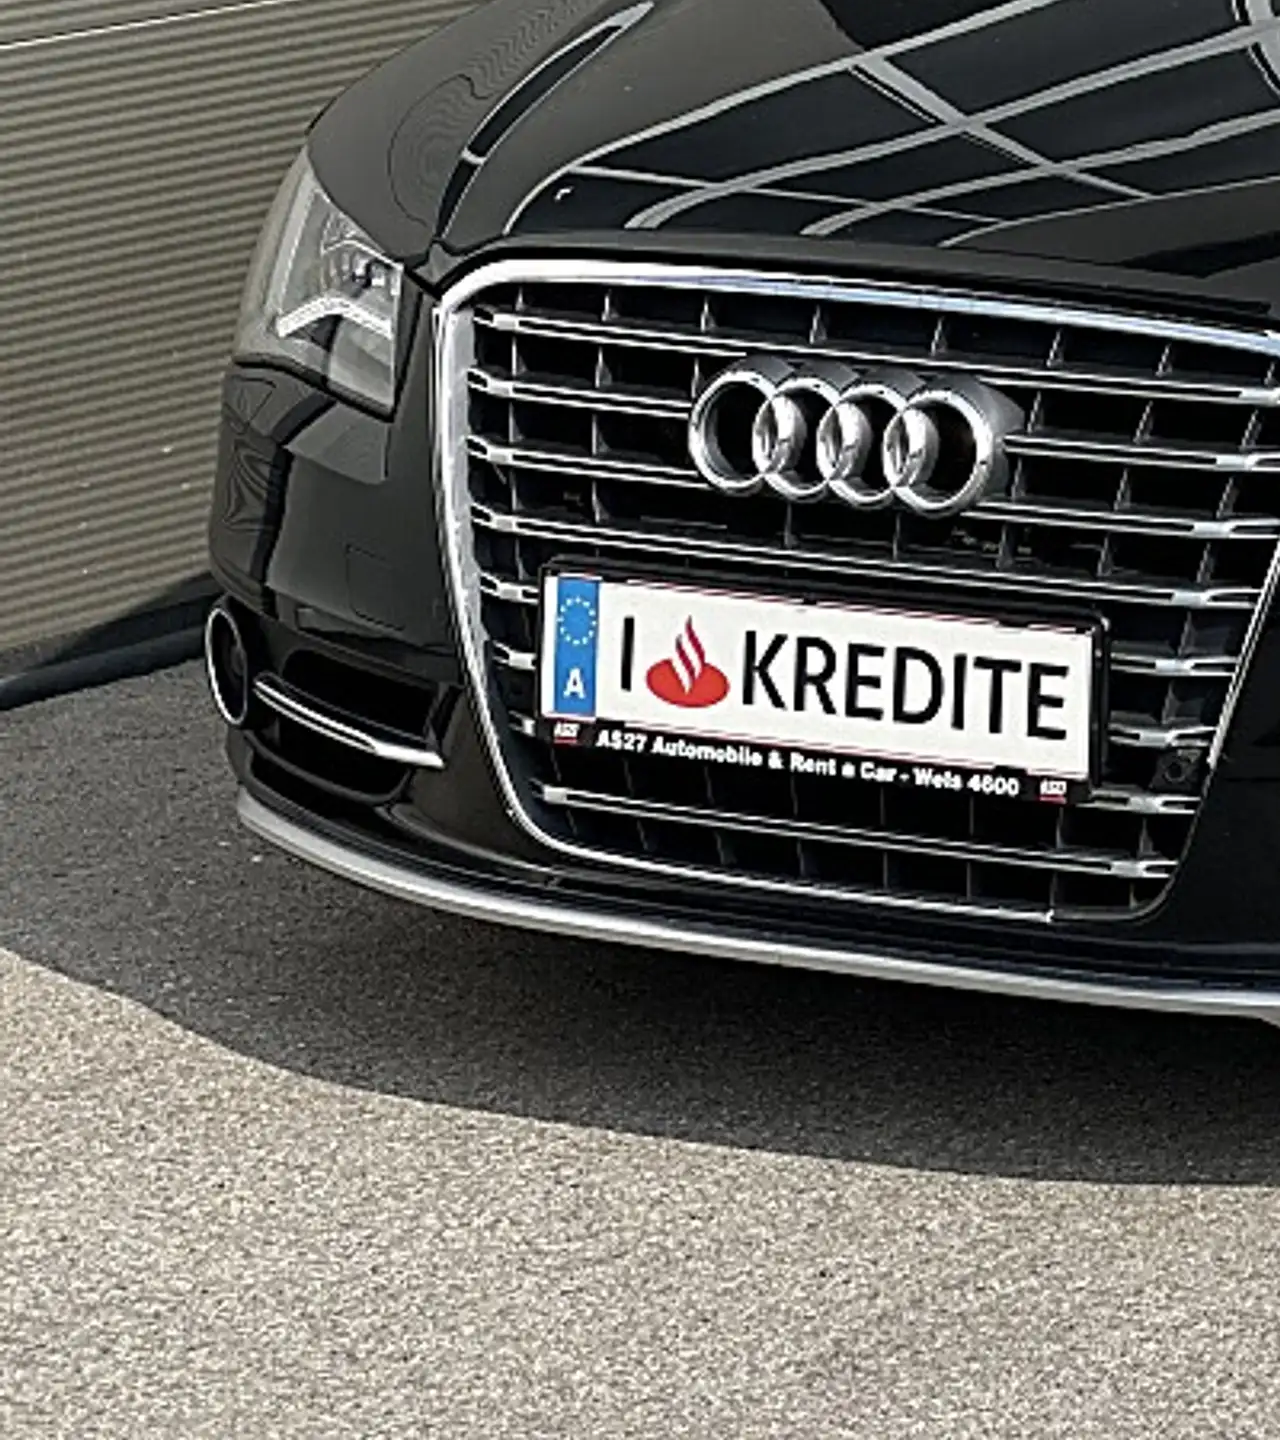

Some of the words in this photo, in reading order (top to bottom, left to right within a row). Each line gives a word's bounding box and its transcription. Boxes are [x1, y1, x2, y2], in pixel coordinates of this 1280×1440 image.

[563, 667, 585, 700] A
[620, 616, 635, 692] I
[742, 630, 1070, 741] KREDITE
[596, 730, 647, 752] AS27
[651, 736, 762, 767] Automobile
[768, 750, 783, 769] &
[790, 752, 836, 777] Rent
[860, 762, 897, 782] Car
